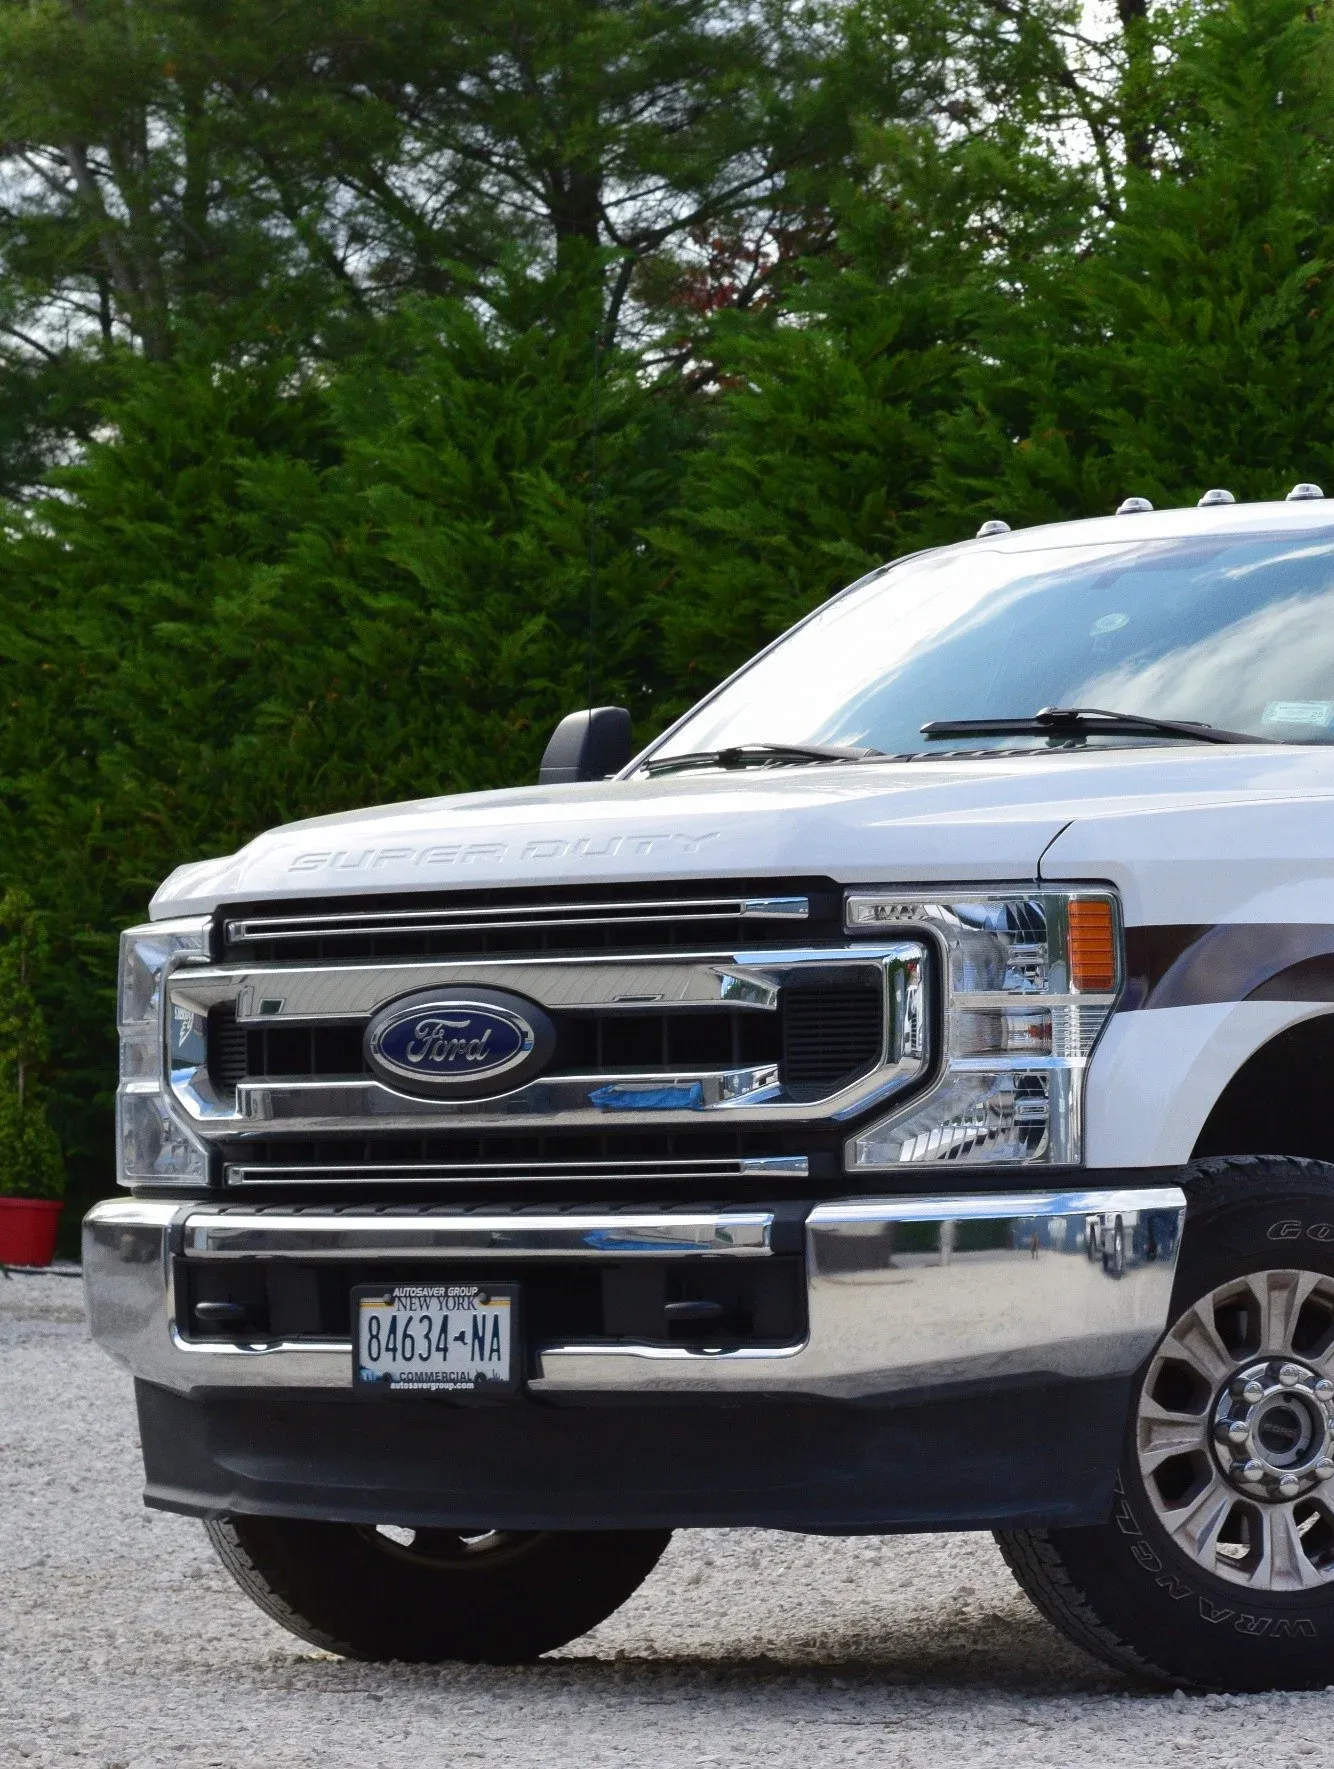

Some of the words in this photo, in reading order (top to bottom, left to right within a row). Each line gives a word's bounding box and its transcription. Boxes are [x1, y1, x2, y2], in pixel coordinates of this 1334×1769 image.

[288, 842, 510, 874] SUPER
[518, 831, 721, 862] DUTY
[406, 1018, 492, 1063] Ford
[393, 1287, 445, 1297] AUTOSAVER
[447, 1286, 478, 1296] GROUP
[396, 1297, 431, 1311] NEW
[437, 1297, 478, 1311] YORK
[368, 1314, 449, 1362] 84634
[470, 1314, 501, 1361] NA
[390, 1382, 474, 1391] autosavergroup.com
[399, 1371, 473, 1382] COMMERCIAL
[1114, 1467, 1317, 1638] WRANGL
